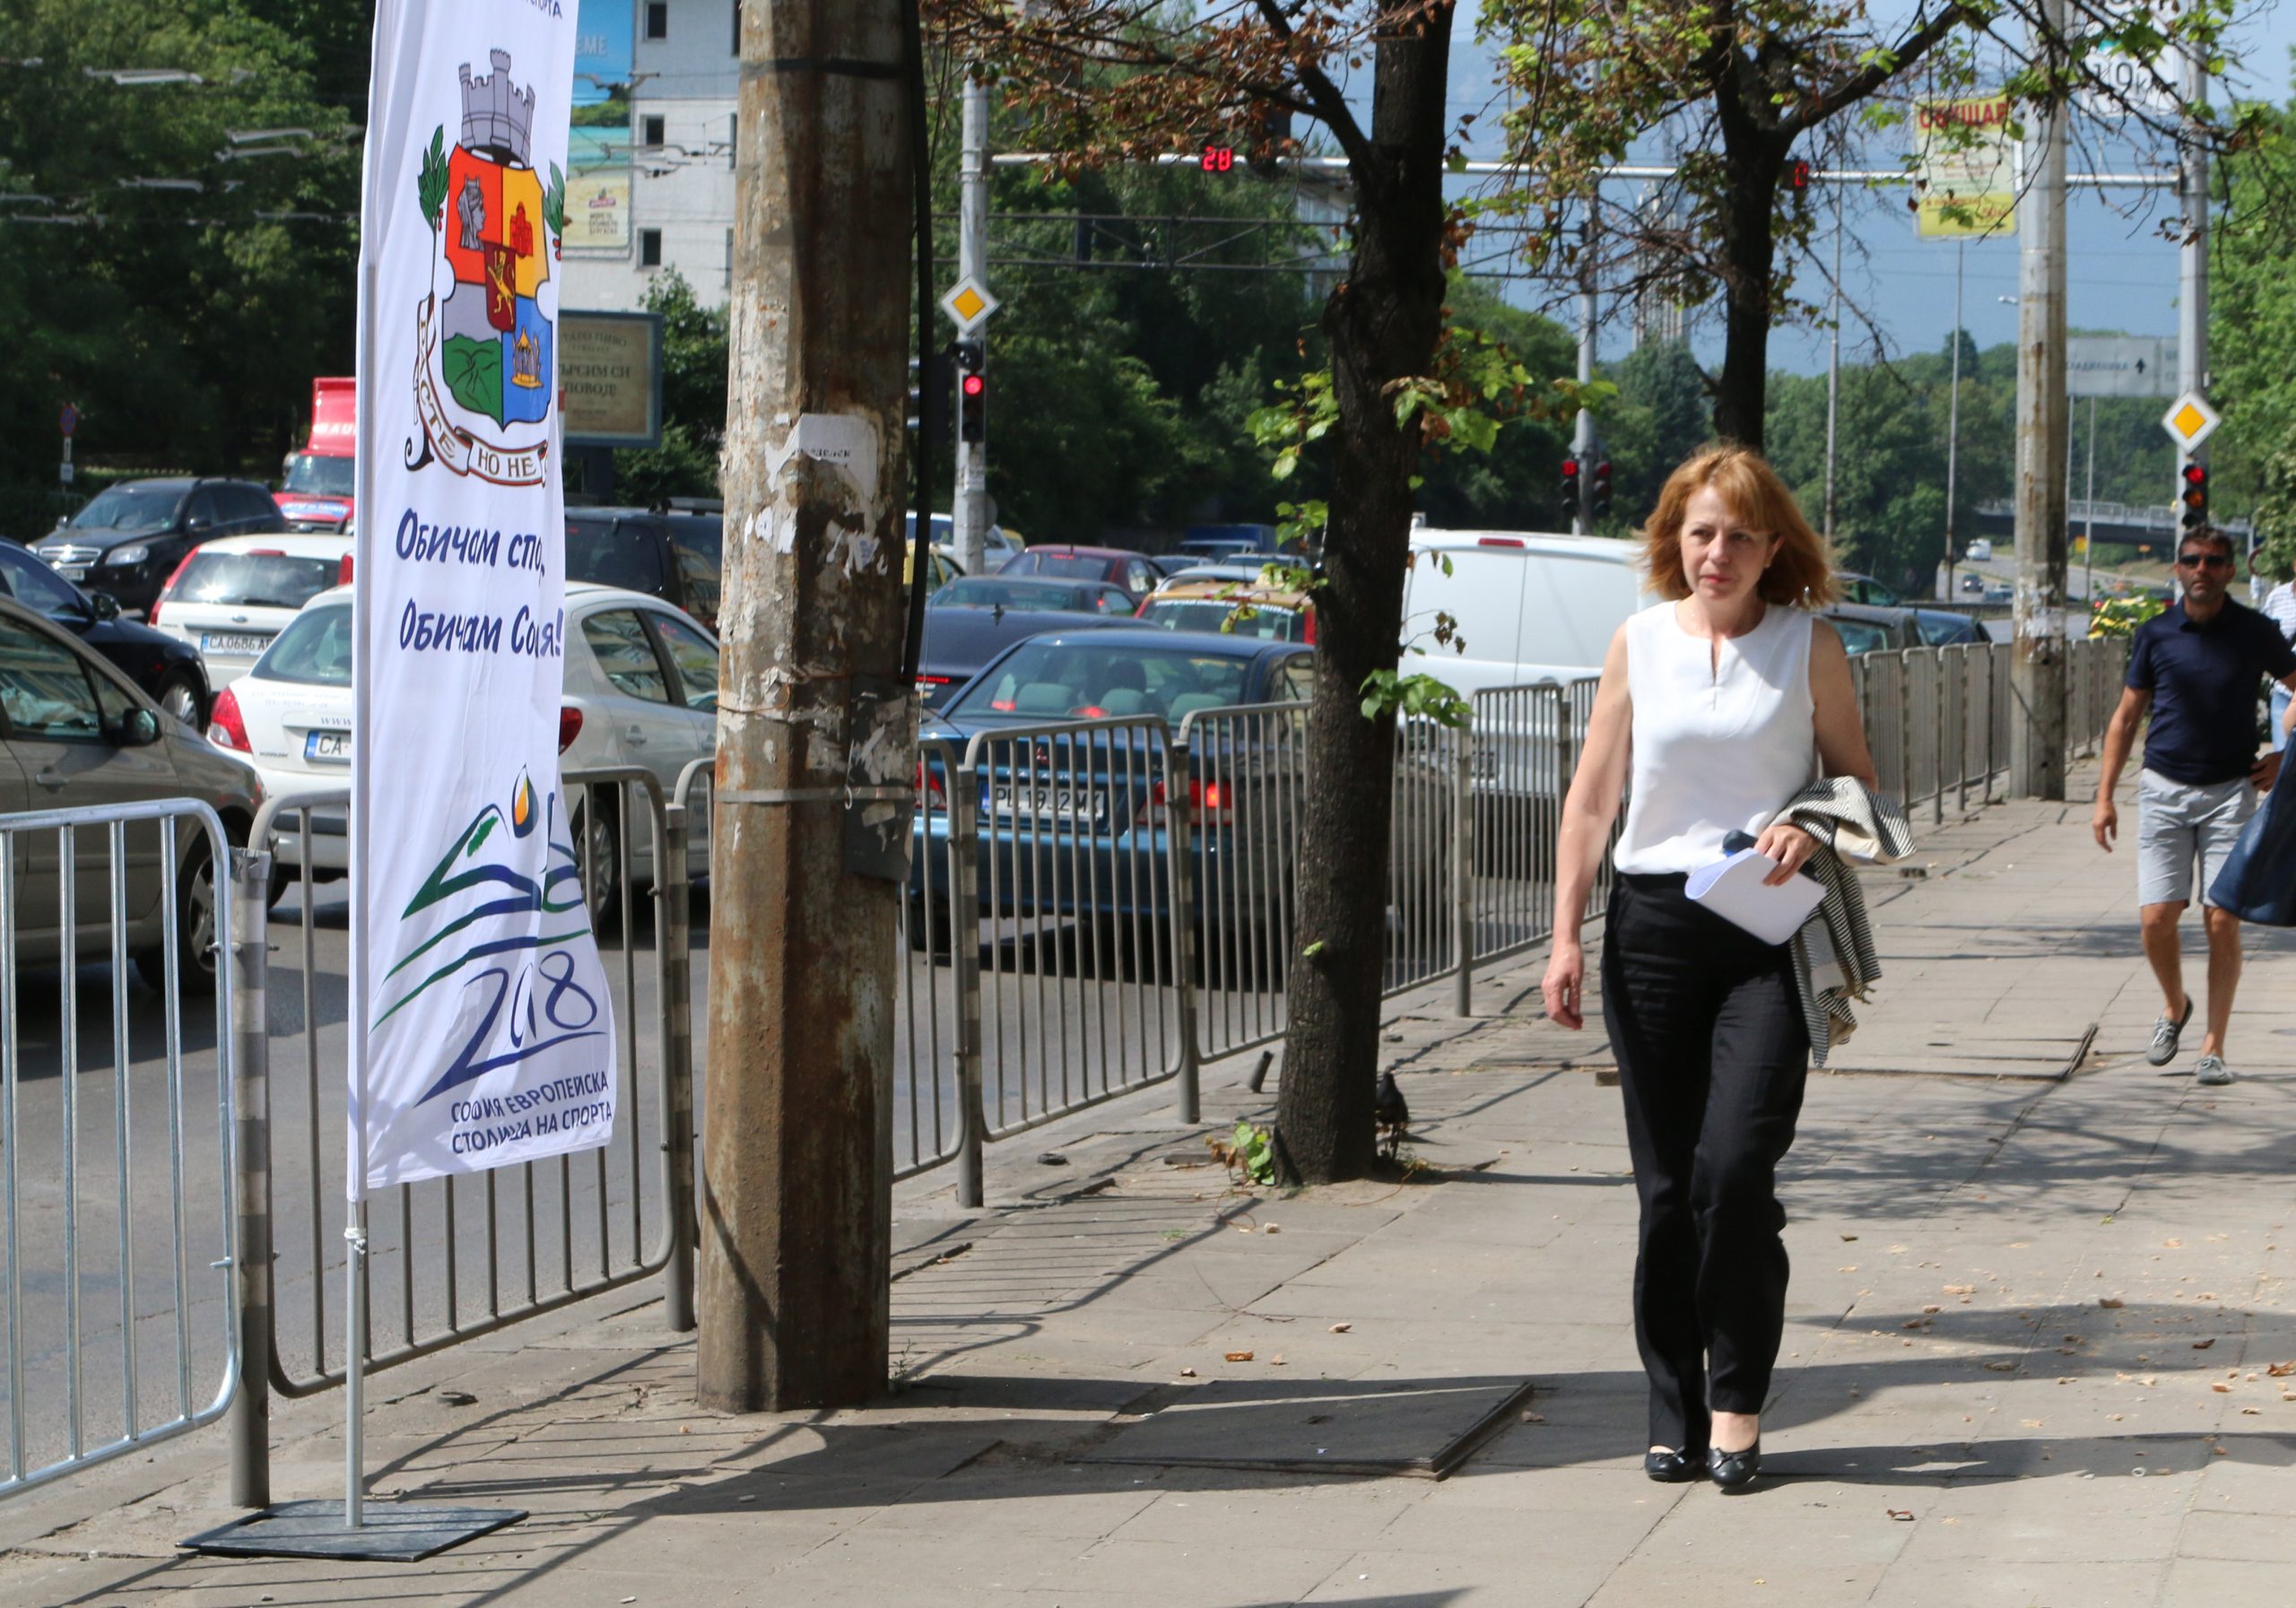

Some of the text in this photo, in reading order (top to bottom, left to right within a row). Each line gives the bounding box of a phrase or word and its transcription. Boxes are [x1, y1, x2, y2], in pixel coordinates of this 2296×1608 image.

[477, 446, 537, 478] НО НЕ
[451, 1071, 609, 1123] СОФИЯ ЕВРОПЕЙСКА
[536, 1112, 558, 1135] НА
[561, 1100, 612, 1130] СПОРТА
